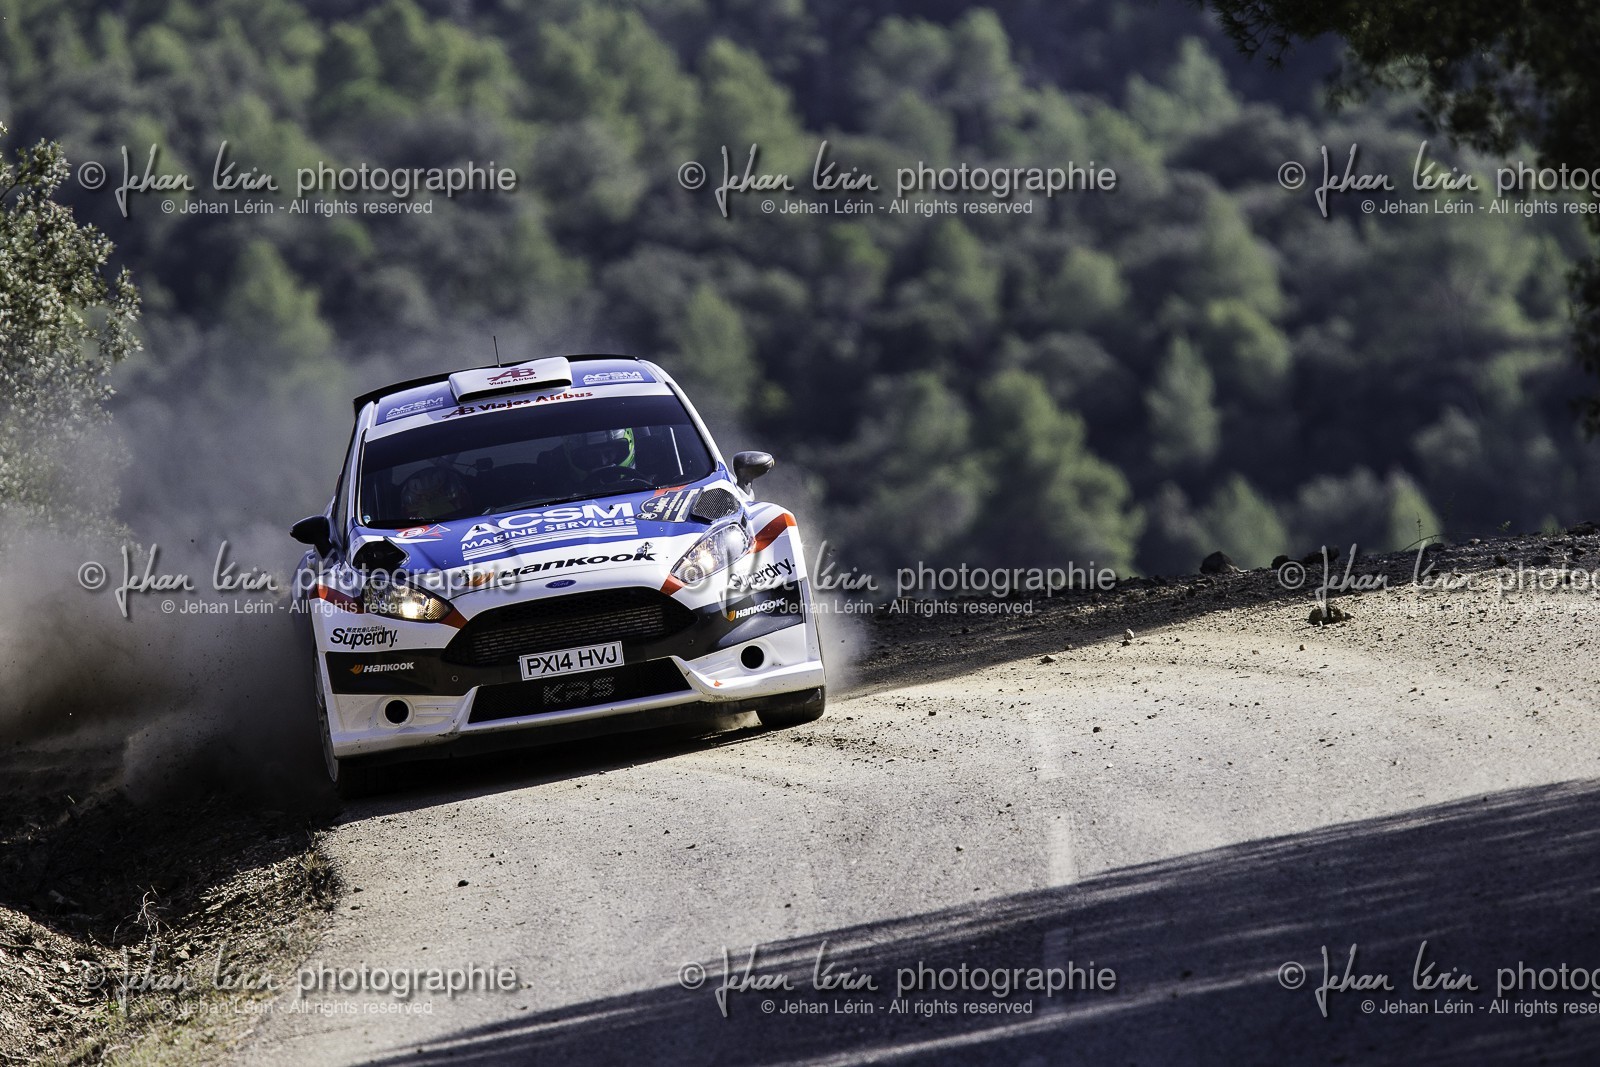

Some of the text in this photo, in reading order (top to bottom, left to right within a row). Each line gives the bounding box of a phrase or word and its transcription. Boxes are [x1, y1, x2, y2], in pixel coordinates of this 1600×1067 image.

[387, 397, 443, 414] ACSM
[478, 398, 531, 412] Viajes
[536, 391, 593, 404] Airbus
[460, 503, 635, 542] ACSM
[461, 517, 637, 551] MARINE SERVICES
[526, 645, 618, 676] PX14 HVJ
